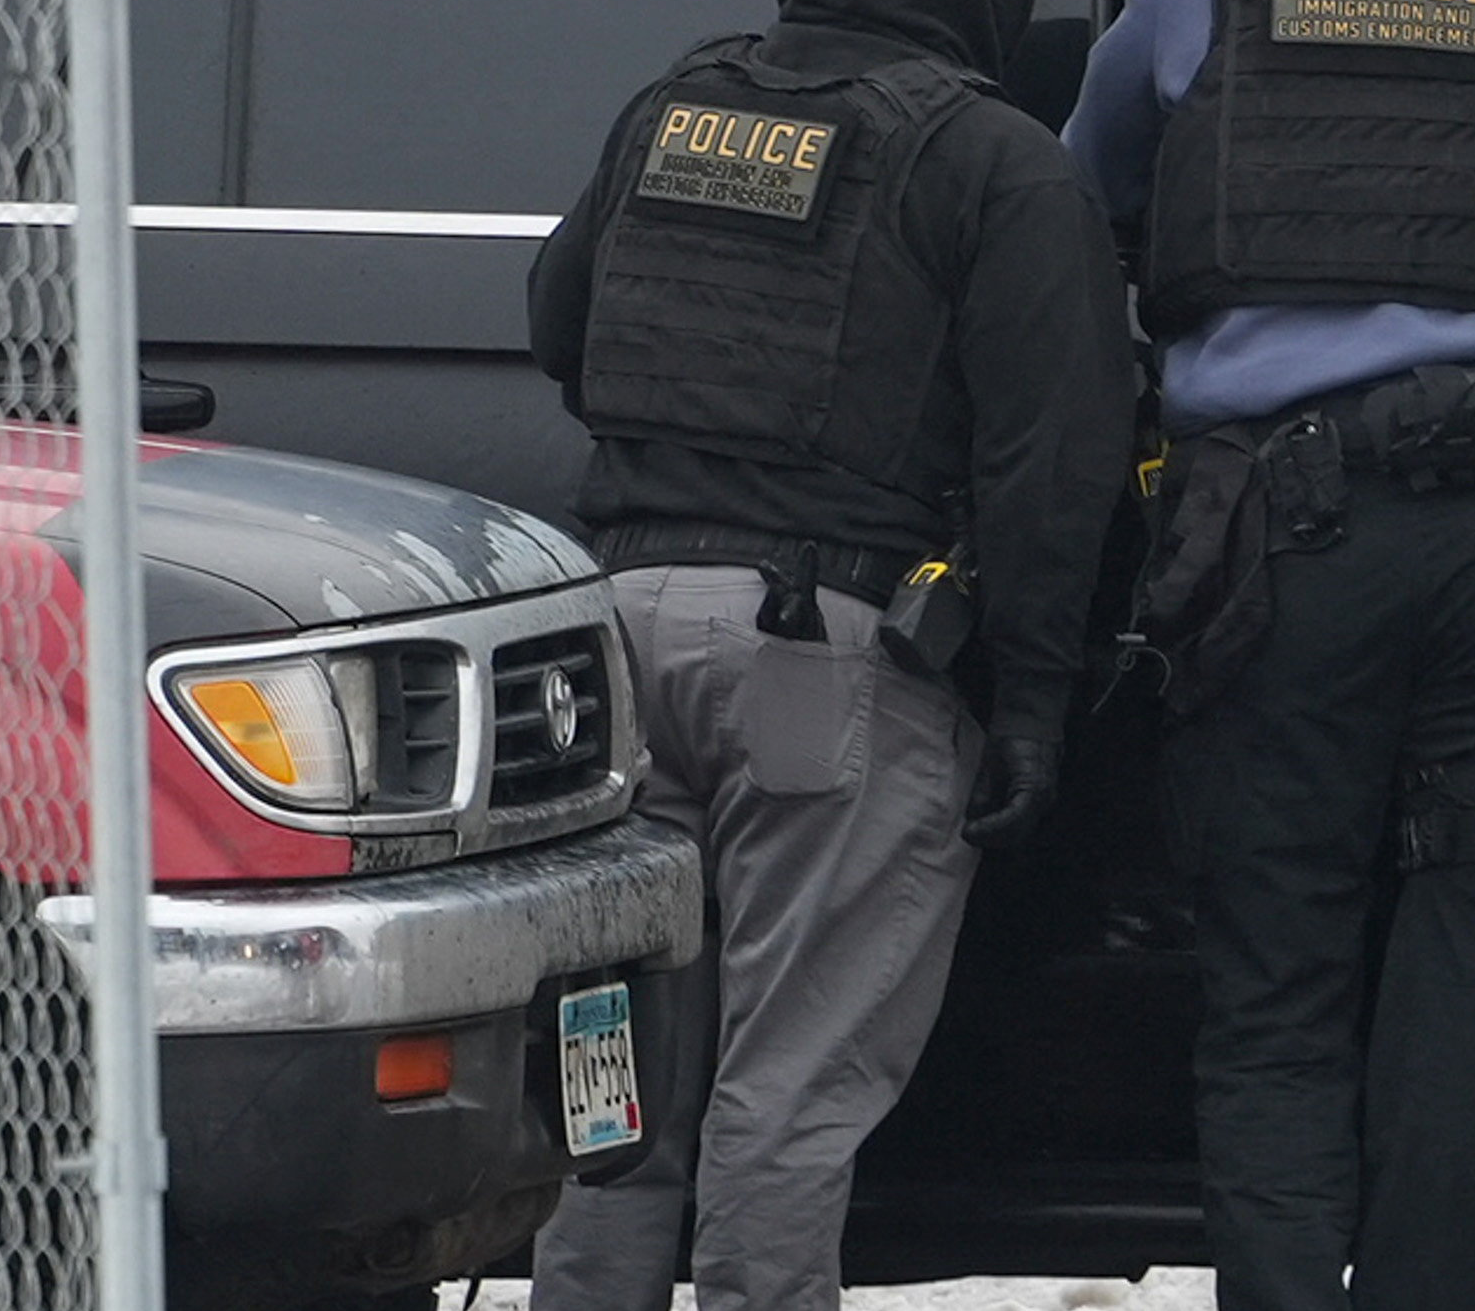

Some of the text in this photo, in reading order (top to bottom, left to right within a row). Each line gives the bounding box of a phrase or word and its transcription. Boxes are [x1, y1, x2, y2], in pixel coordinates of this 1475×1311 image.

[1432, 7, 1471, 26] AND
[1277, 19, 1360, 38] CUSTOMS
[658, 108, 828, 171] POLICE
